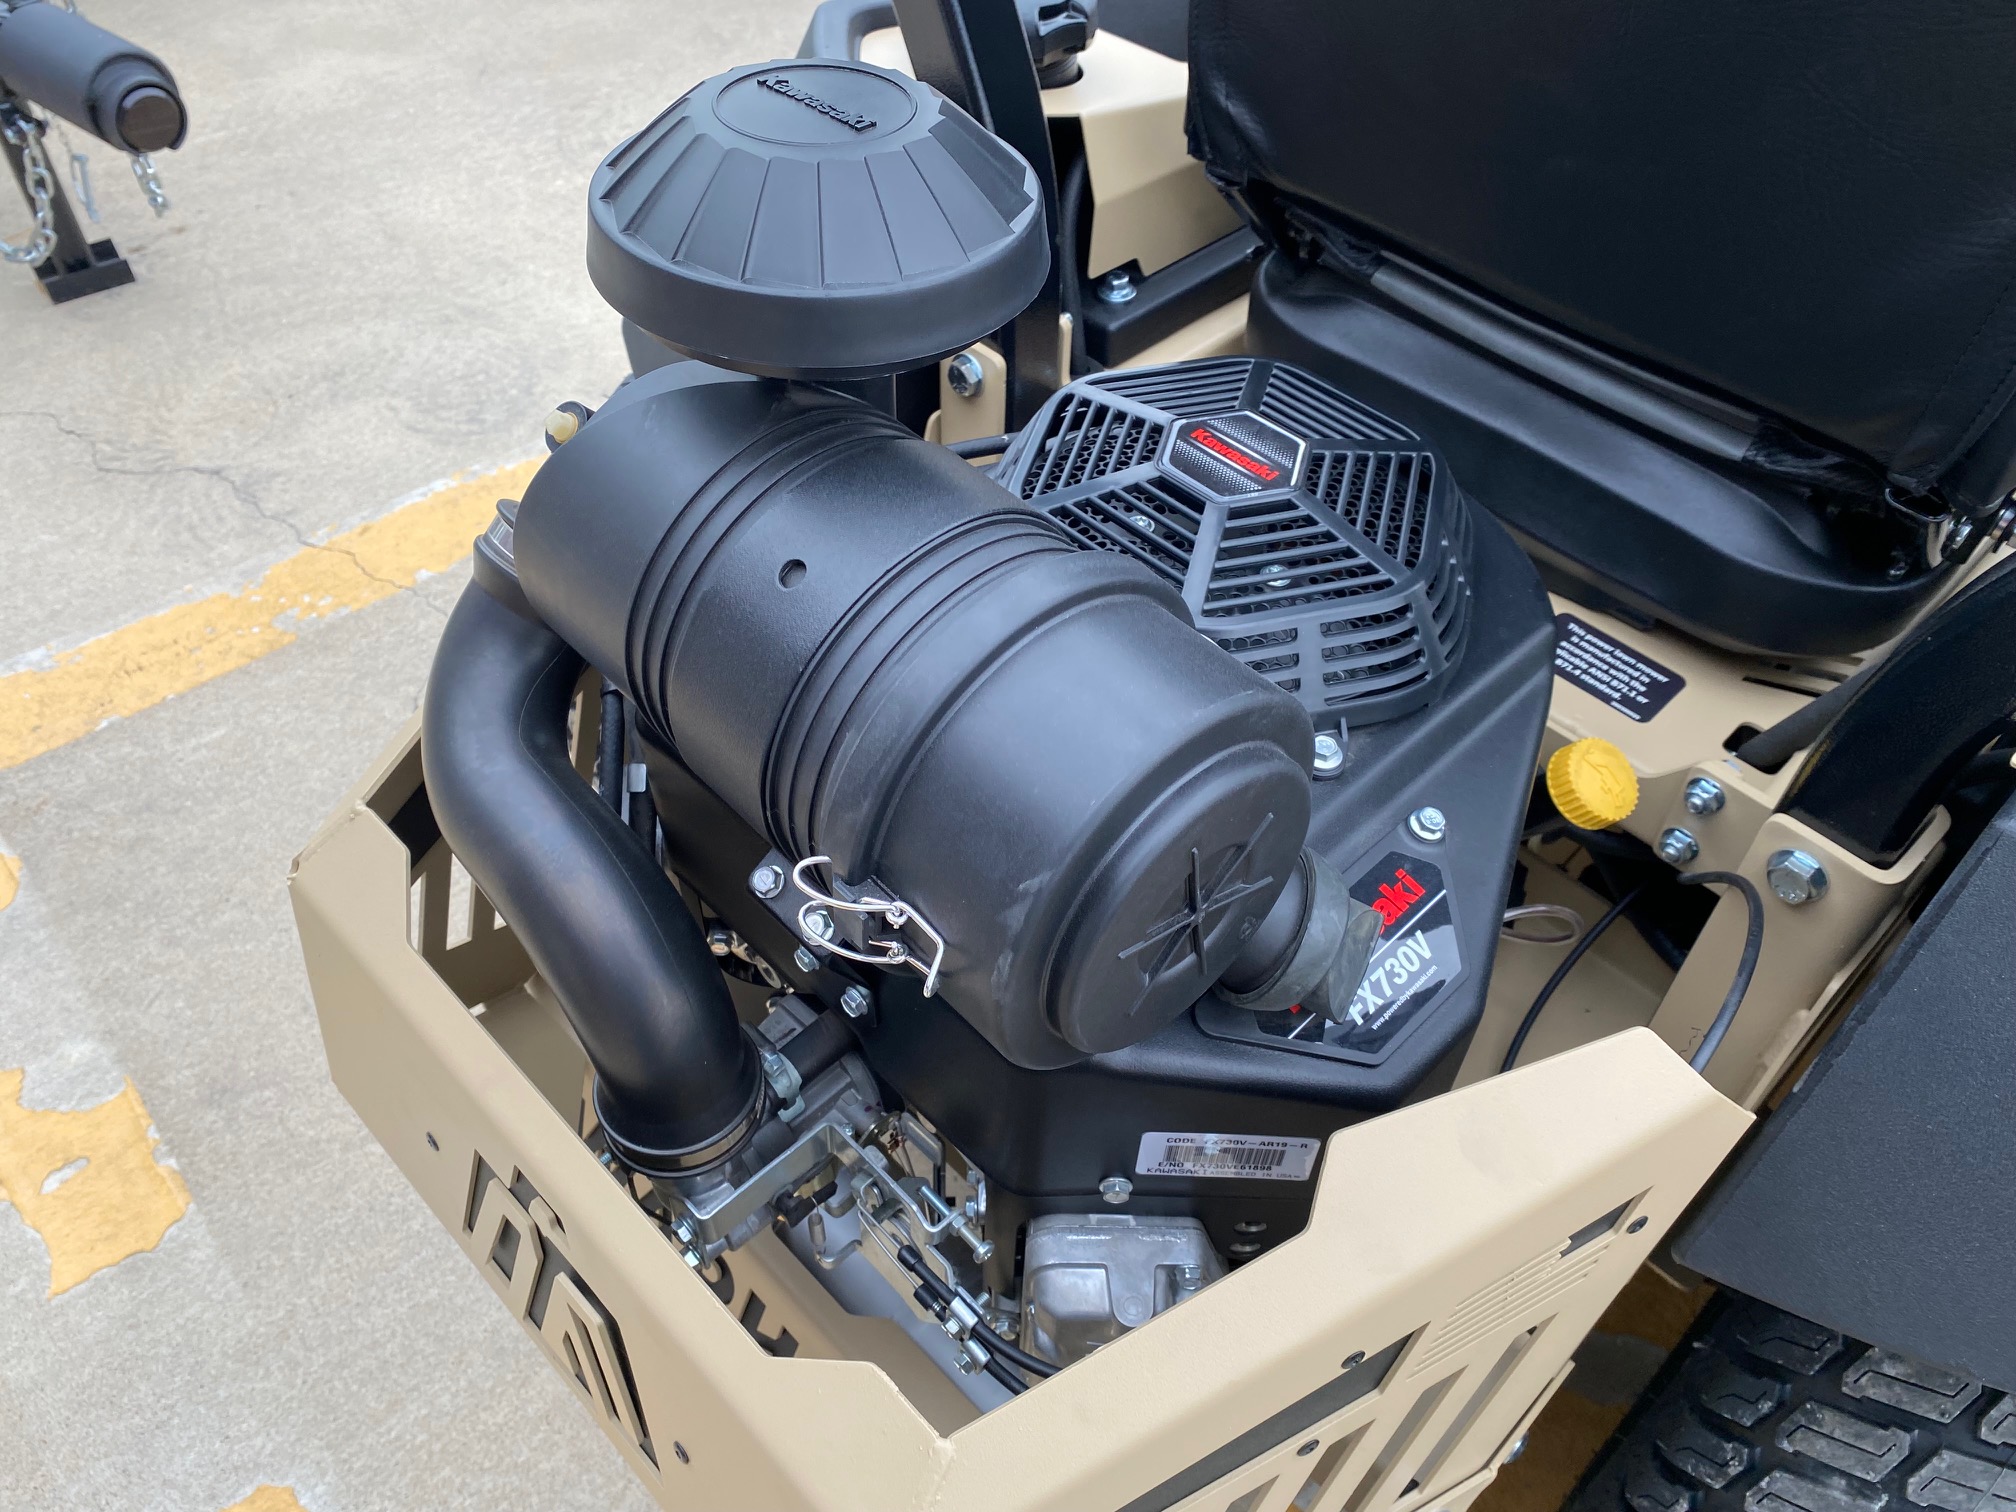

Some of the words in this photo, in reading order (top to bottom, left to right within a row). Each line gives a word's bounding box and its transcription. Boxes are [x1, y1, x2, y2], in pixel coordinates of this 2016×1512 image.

[756, 74, 877, 132] Kawasaki
[1190, 428, 1280, 481] Kawasaki
[1584, 633, 1615, 652] power
[1635, 661, 1670, 683] mower
[1349, 929, 1432, 1026] FX730V
[1371, 964, 1438, 1030] www.poweredbykawasaki.com
[1166, 1137, 1196, 1145] CODE
[1146, 1168, 1208, 1176] KAWASAKI
